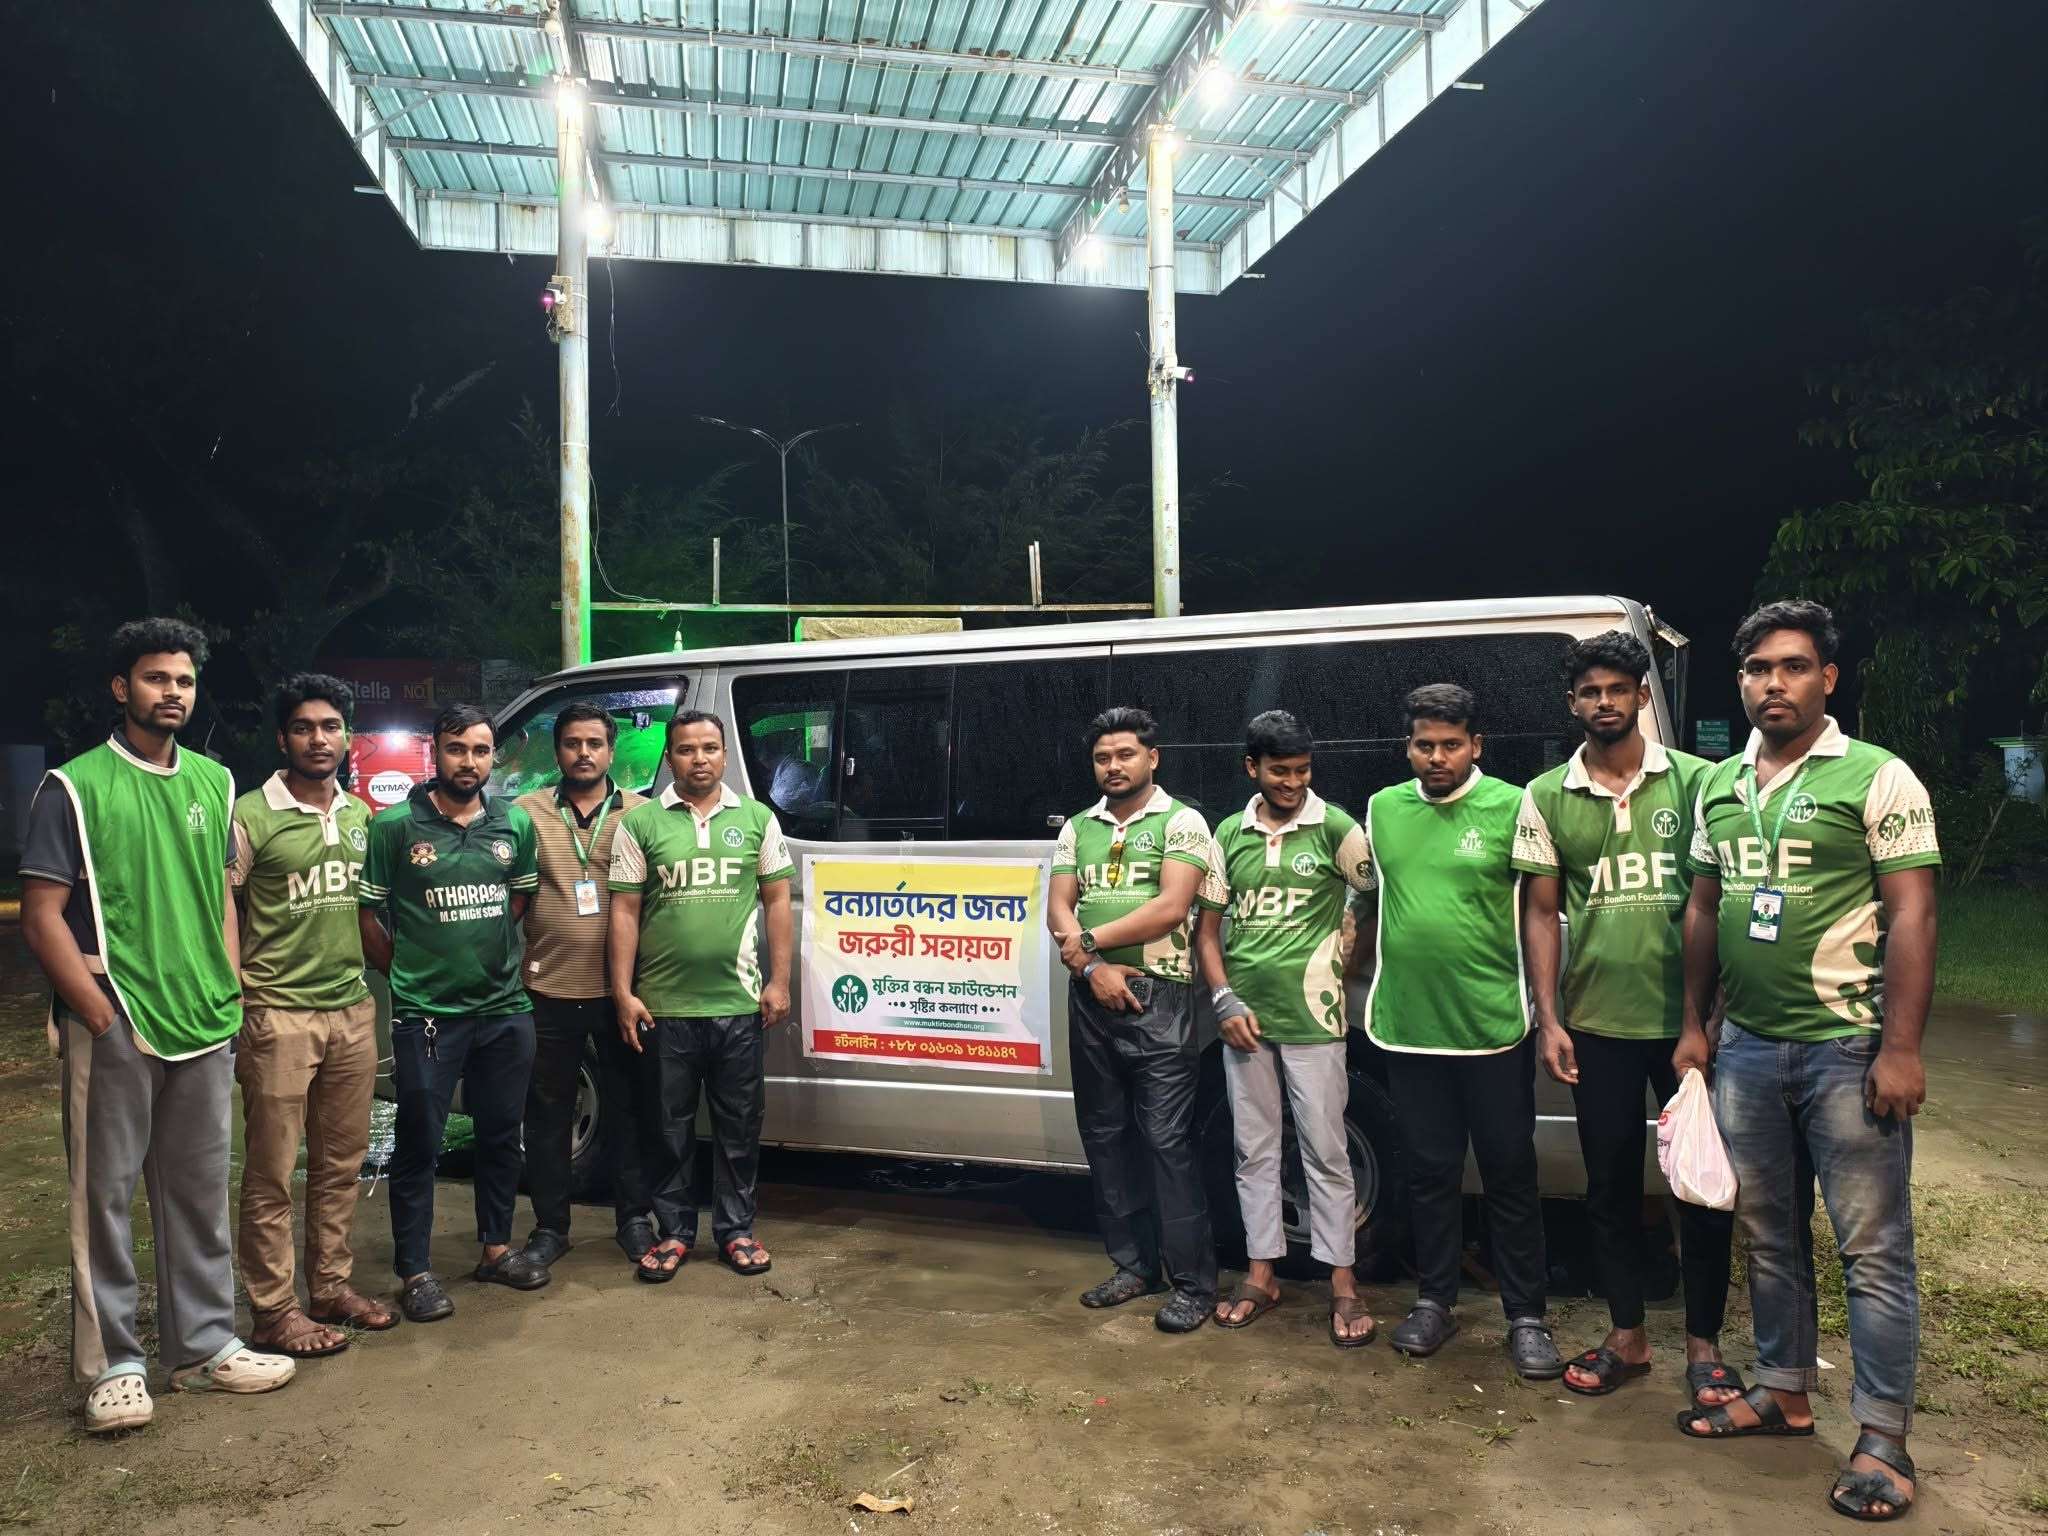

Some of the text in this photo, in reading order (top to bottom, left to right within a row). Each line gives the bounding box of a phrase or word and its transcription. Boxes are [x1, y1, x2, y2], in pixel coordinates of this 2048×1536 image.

[371, 782, 410, 793] PLYMAX
[1910, 807, 1935, 825] MB
[1187, 831, 1210, 846] MBF
[1519, 825, 1539, 840] BF
[656, 857, 743, 889] MBF
[1757, 881, 1813, 894] Fundation
[823, 880, 1029, 923] বন্যার্তদের জন্য
[1604, 894, 1637, 904] Bondhon
[1638, 892, 1680, 901] Foundation
[837, 924, 1012, 962] জরুরী সহায়তা
[871, 975, 1018, 999] মুক্তির বন্ধন ফাউন্ডেশন
[909, 997, 978, 1015] সৃষ্টির কল্যাণে
[834, 1034, 878, 1050] হটলাইন
